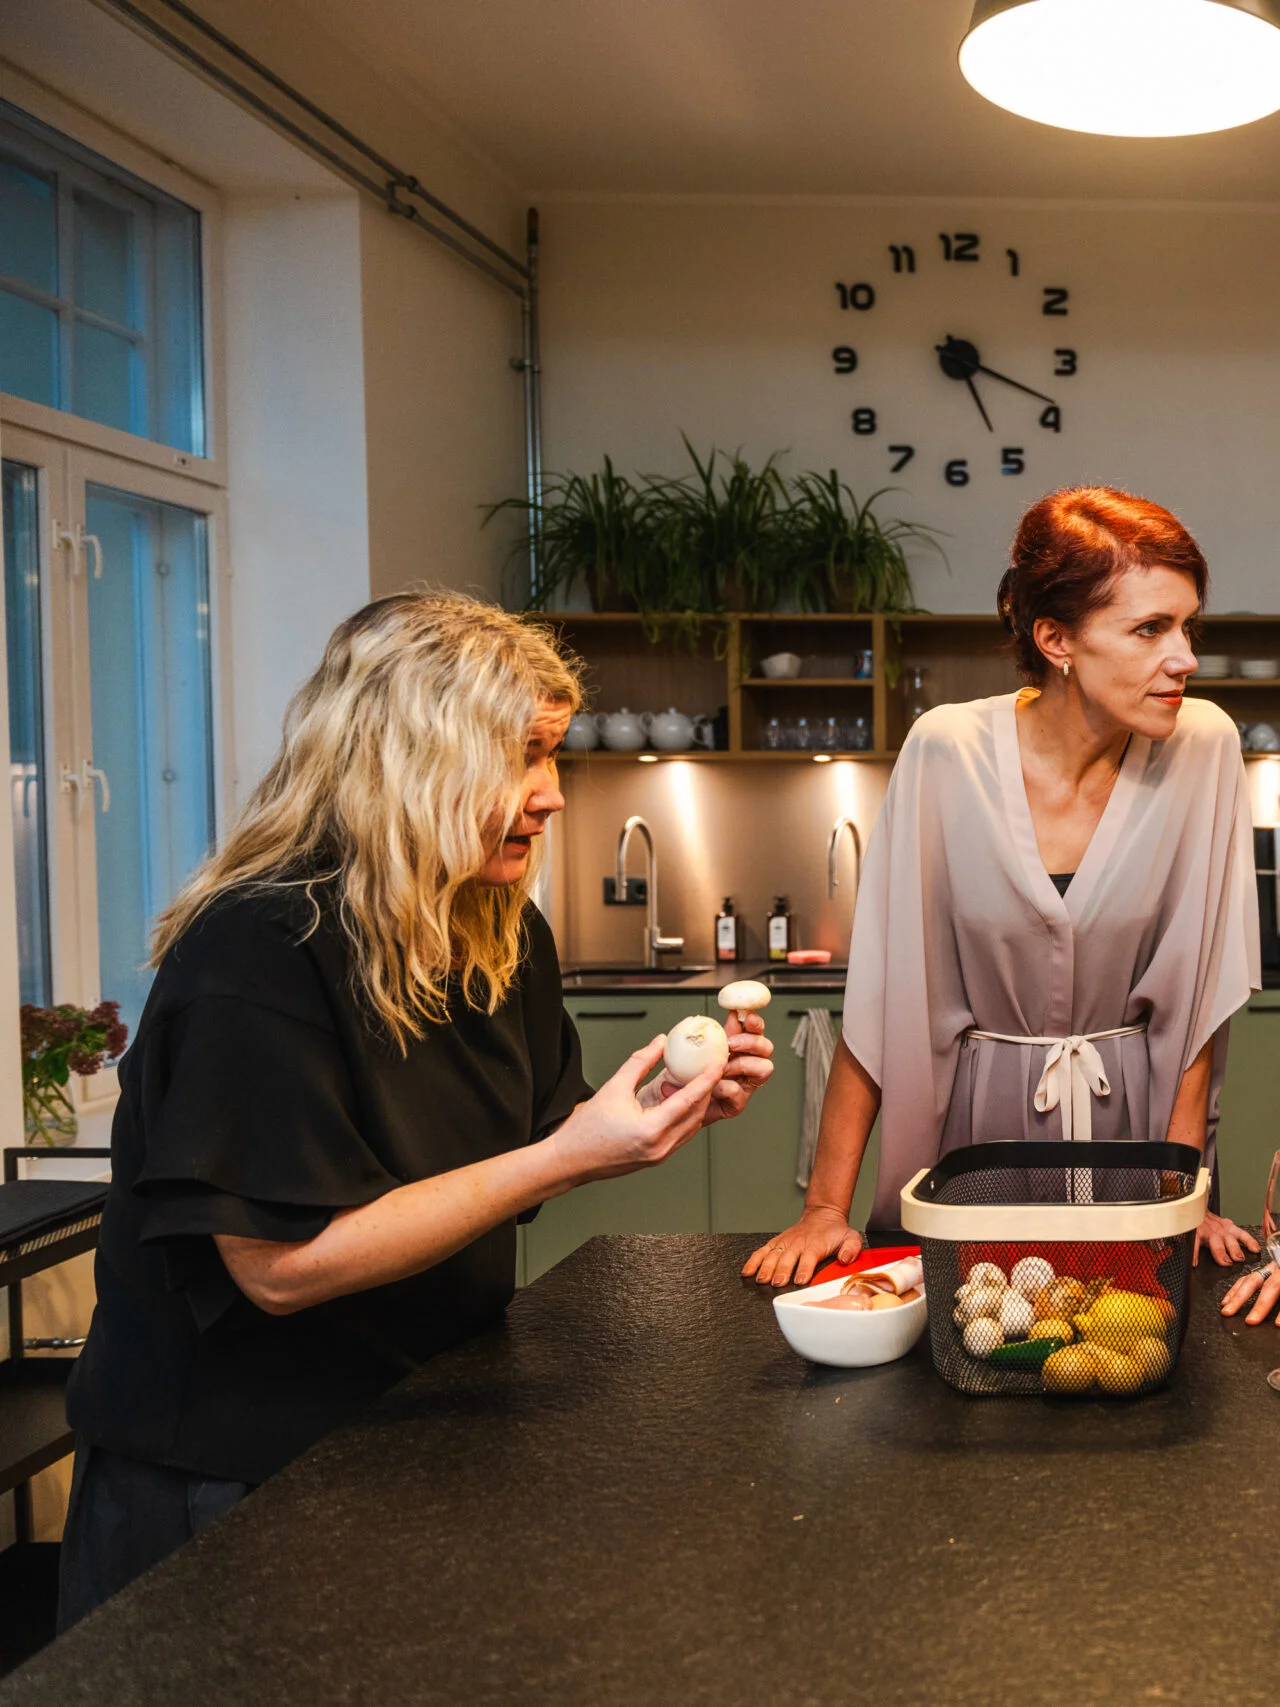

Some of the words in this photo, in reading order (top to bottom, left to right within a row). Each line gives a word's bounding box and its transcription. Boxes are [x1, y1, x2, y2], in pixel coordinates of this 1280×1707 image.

[888, 244, 916, 274] 11
[938, 233, 980, 262] 12
[1006, 248, 1019, 277] 1
[835, 282, 876, 311] 10
[1042, 287, 1069, 316] 2
[832, 346, 858, 375] 9
[1054, 348, 1078, 377] 3
[851, 407, 877, 436] 8
[1039, 405, 1061, 433] 4
[888, 445, 915, 473] 7
[944, 459, 970, 487] 6
[1001, 447, 1025, 475] 5
